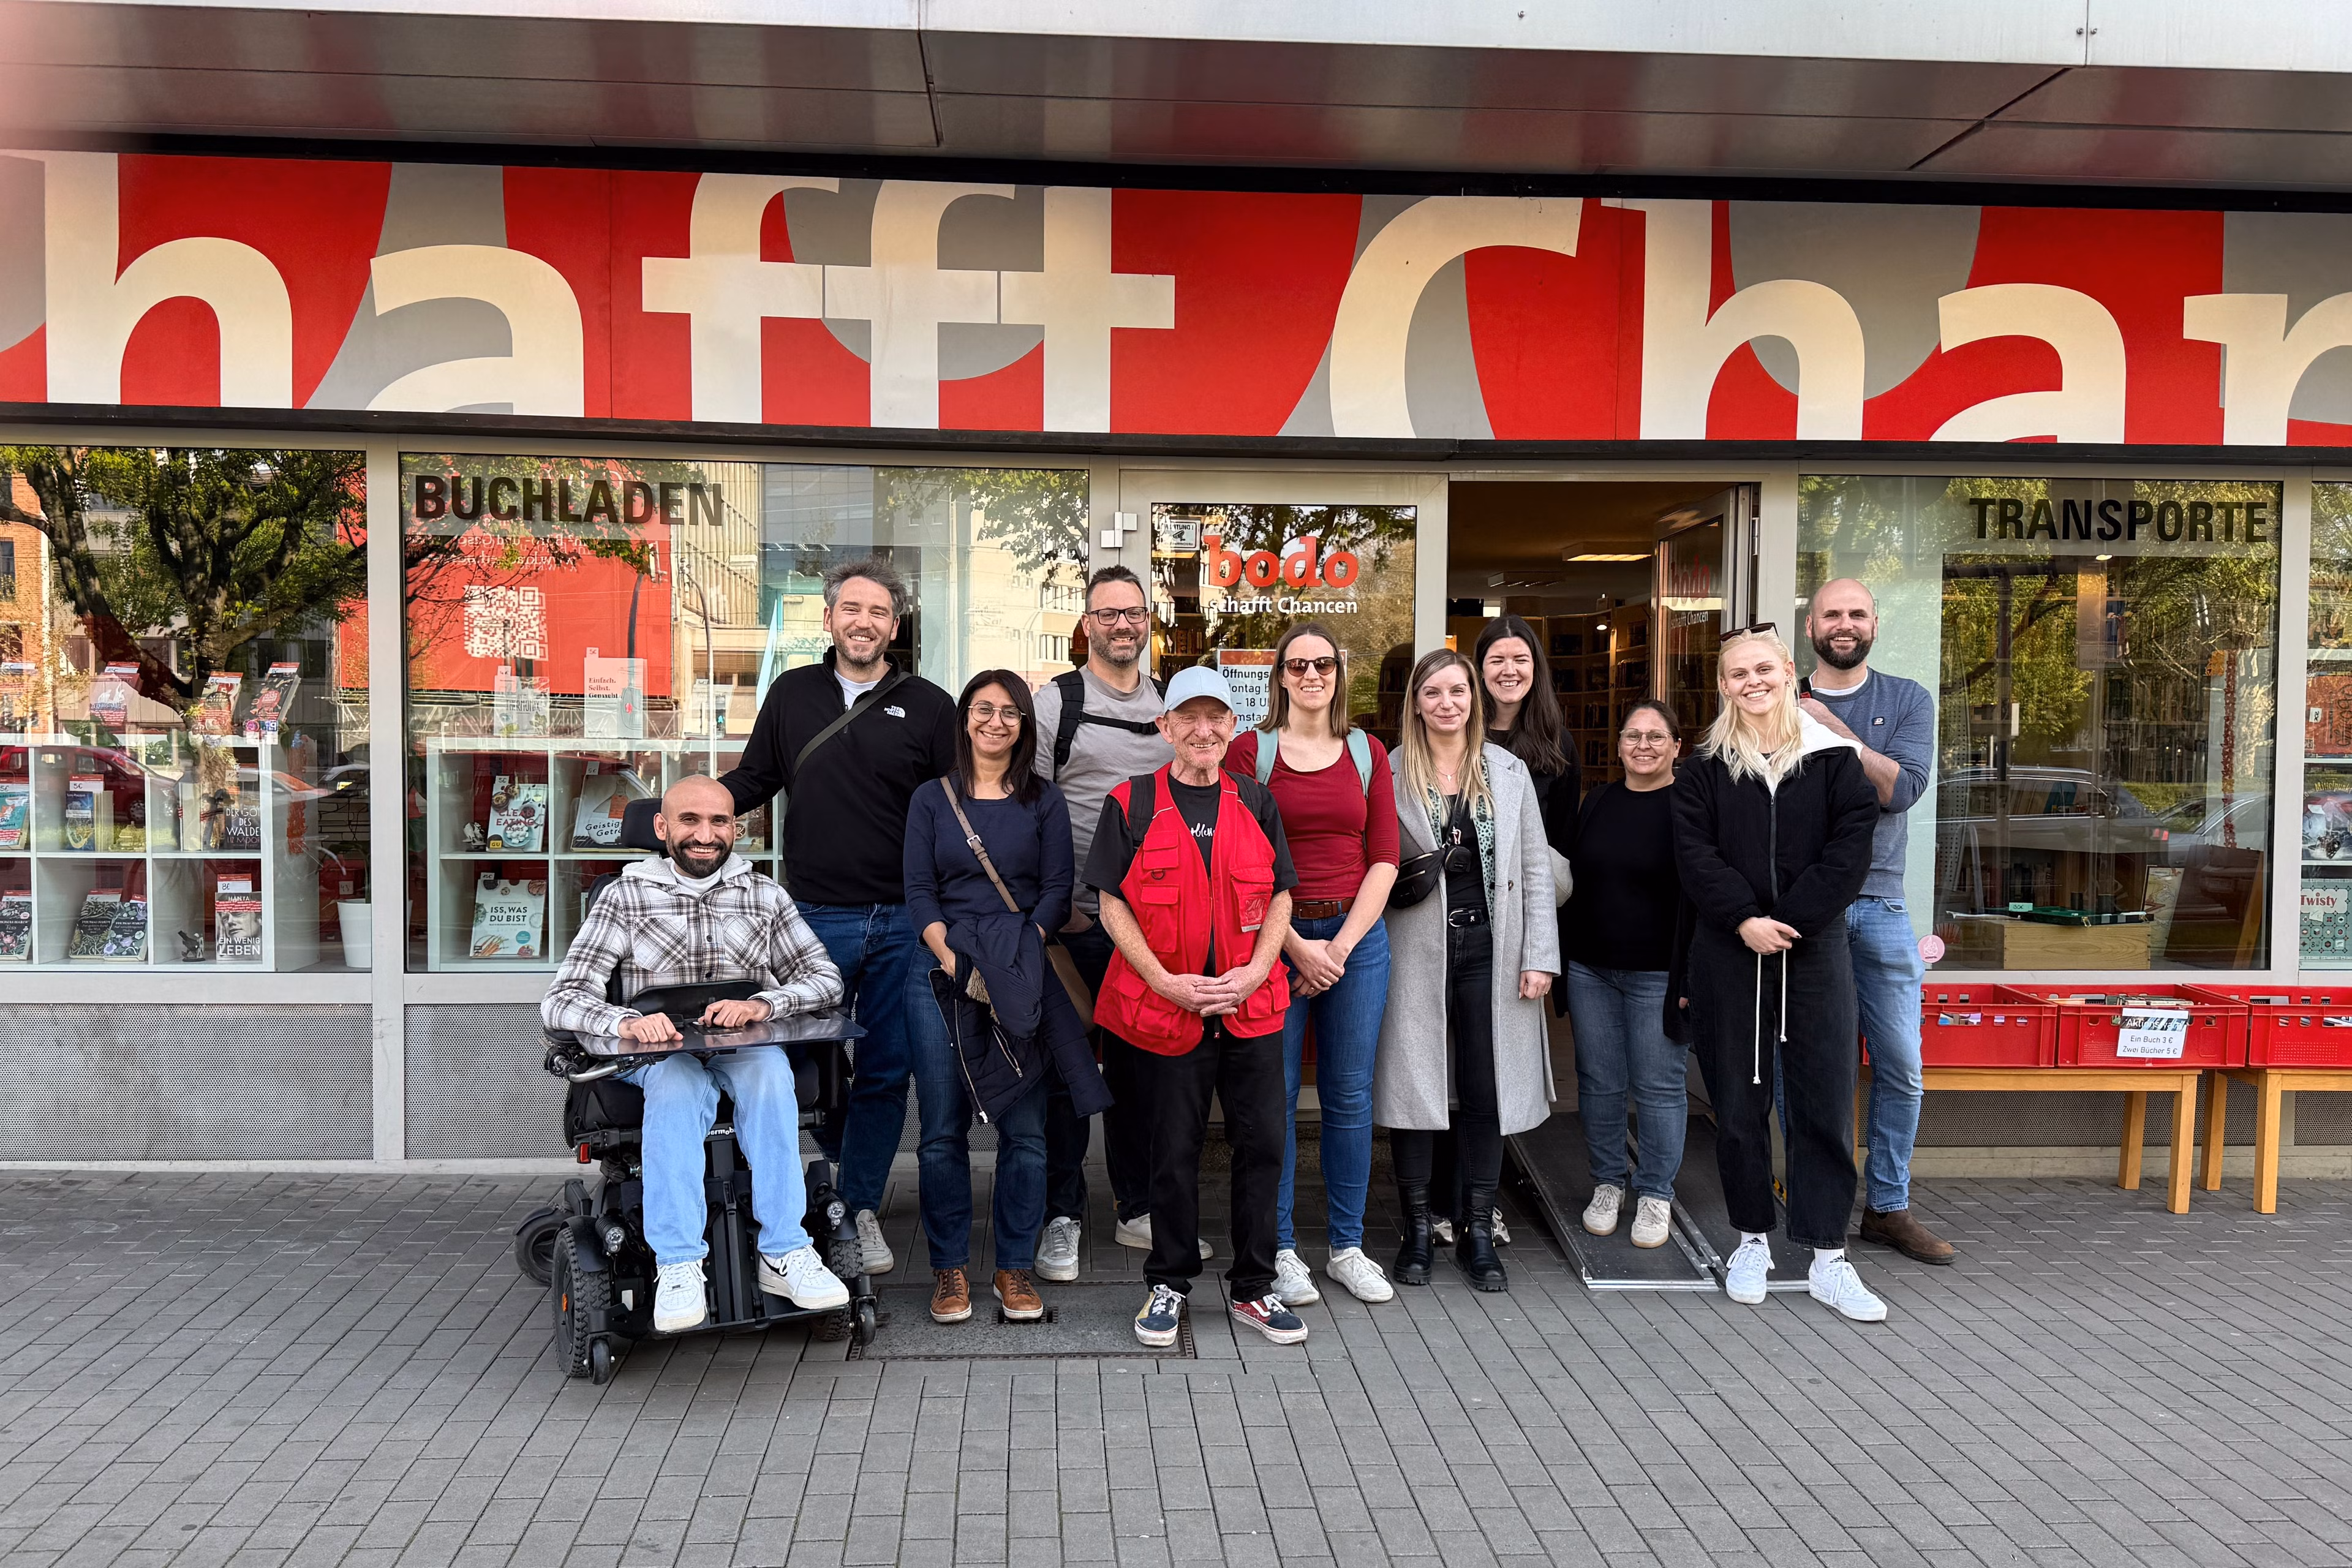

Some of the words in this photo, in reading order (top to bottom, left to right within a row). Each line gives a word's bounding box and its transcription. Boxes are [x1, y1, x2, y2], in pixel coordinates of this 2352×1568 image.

[415, 475, 722, 526] BUCHLADEN
[1970, 498, 2267, 543] TRANSPORTE
[1204, 534, 1359, 588] bodo
[1210, 596, 1272, 614] schafft
[1278, 597, 1357, 614] Chancen
[1223, 666, 1270, 680] Öffnungs
[1229, 684, 1261, 695] ontag
[1246, 698, 1256, 707] 18
[1260, 698, 1269, 707] U
[226, 808, 239, 816] DER
[499, 808, 534, 816] CLEAN
[239, 818, 252, 826] DES
[586, 820, 622, 831] Geistig
[2301, 892, 2337, 908] Twisty
[219, 945, 260, 955] LEBEN
